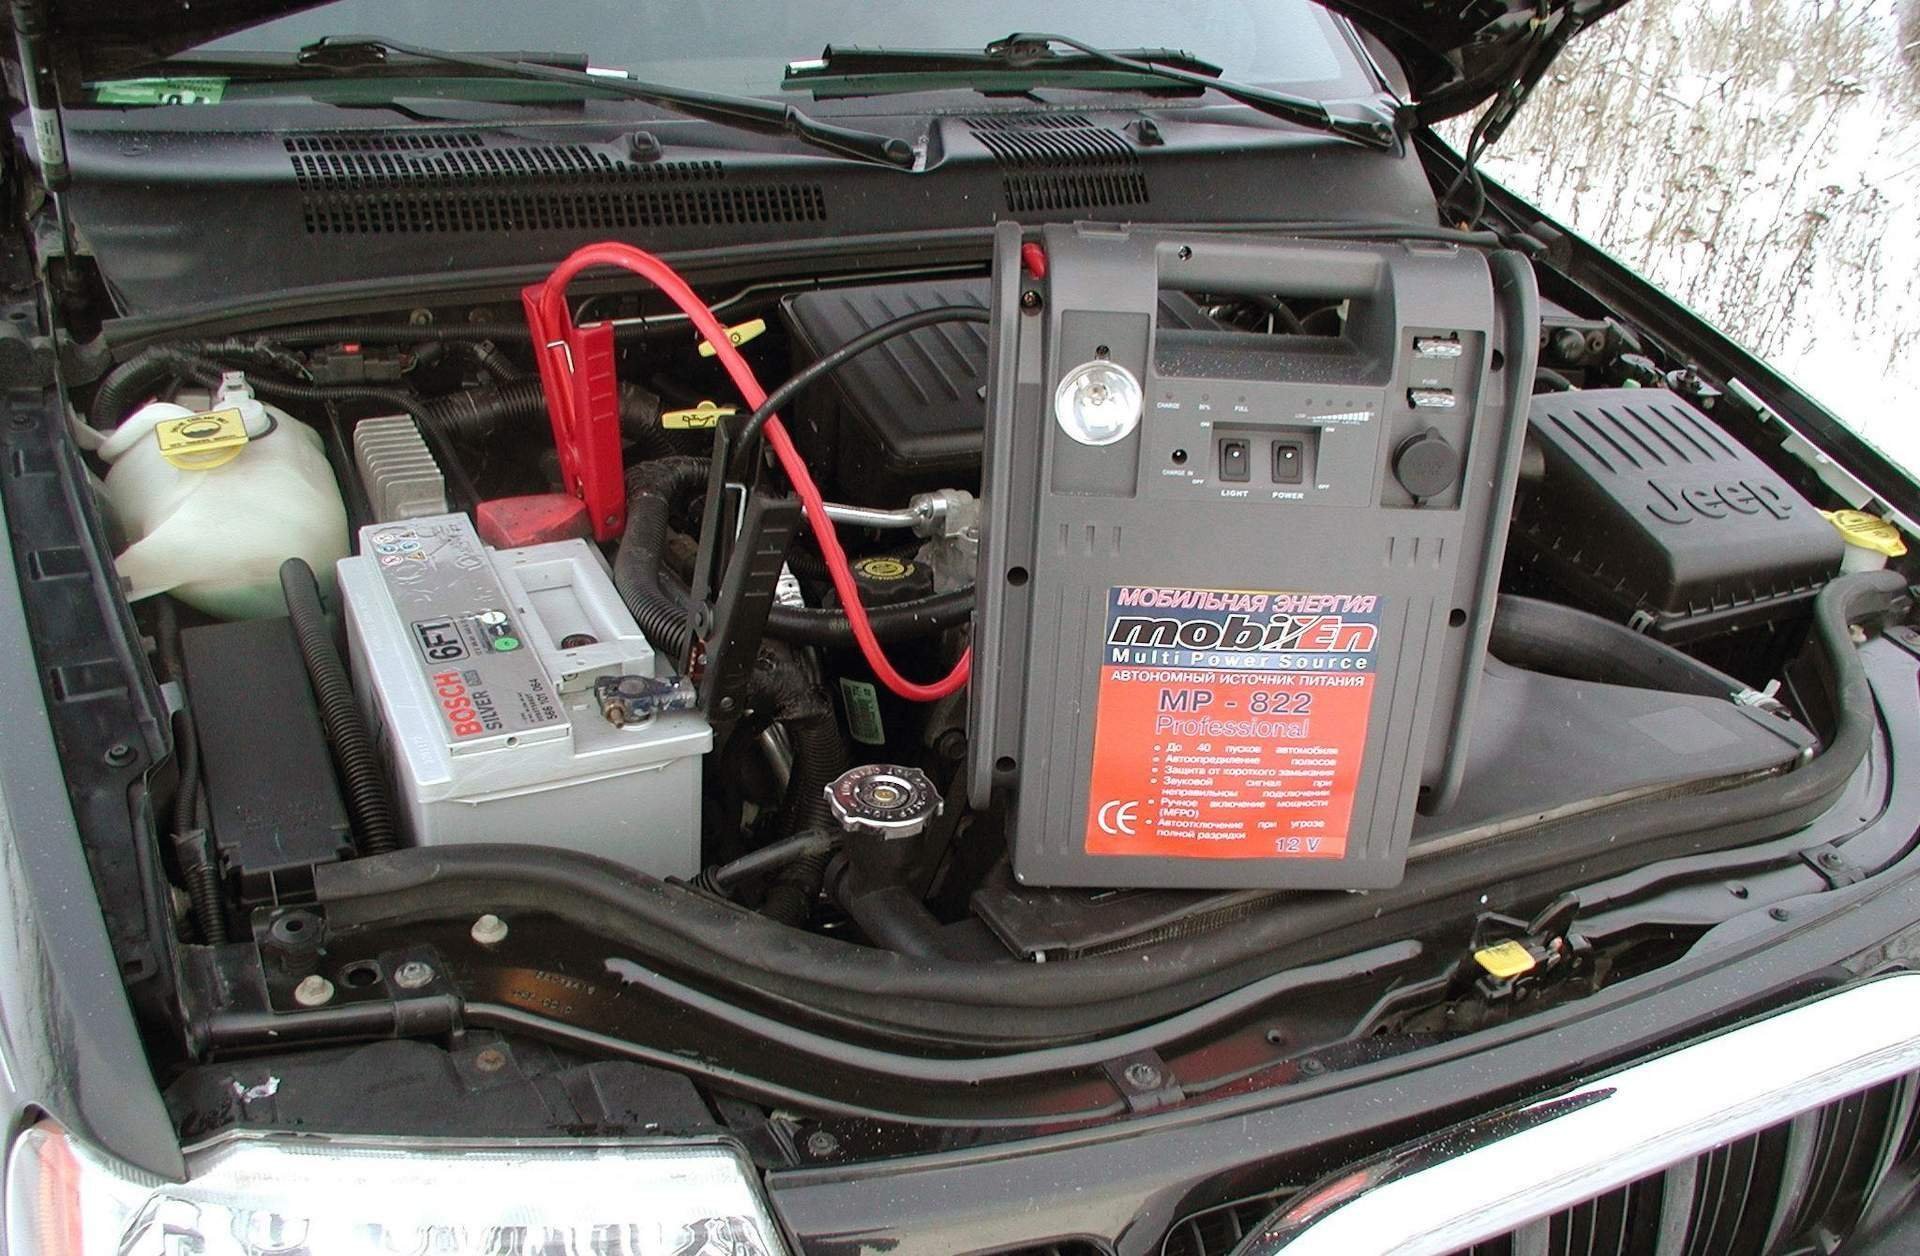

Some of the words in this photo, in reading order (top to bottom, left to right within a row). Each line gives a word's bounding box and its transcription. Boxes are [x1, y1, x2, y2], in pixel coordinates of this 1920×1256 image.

[1220, 489, 1249, 498] LIGHT
[1271, 491, 1305, 500] POWER
[1646, 479, 1792, 525] Jeep
[1117, 588, 1268, 612] МОБИЛЬНАЯ
[1271, 594, 1377, 613] ЭНЕРГИЯ
[1112, 647, 1181, 666] Multi
[1190, 651, 1270, 668] Power
[1279, 654, 1368, 670] Source
[1111, 669, 1216, 684] АВТОНОМНЫЙ
[1219, 672, 1297, 686] ИСТОЧНИК
[1299, 675, 1365, 688] ПИТАНИЯ
[431, 670, 484, 737] BOSCH
[471, 689, 503, 731] SILVER
[1159, 688, 1214, 712] MP
[1249, 690, 1313, 716] 822
[1154, 715, 1310, 739] Professional
[1165, 742, 1183, 753] До
[1197, 742, 1212, 753] 40
[1162, 775, 1214, 787] Звуковой
[1311, 779, 1334, 788] при
[1207, 768, 1220, 776] от
[1223, 768, 1277, 778] короткого
[1160, 796, 1200, 808] Ручное
[1275, 800, 1329, 809] мощности
[1096, 799, 1140, 836] CE
[1256, 820, 1278, 830] при
[1275, 836, 1301, 852] 12
[1306, 836, 1322, 851] V
